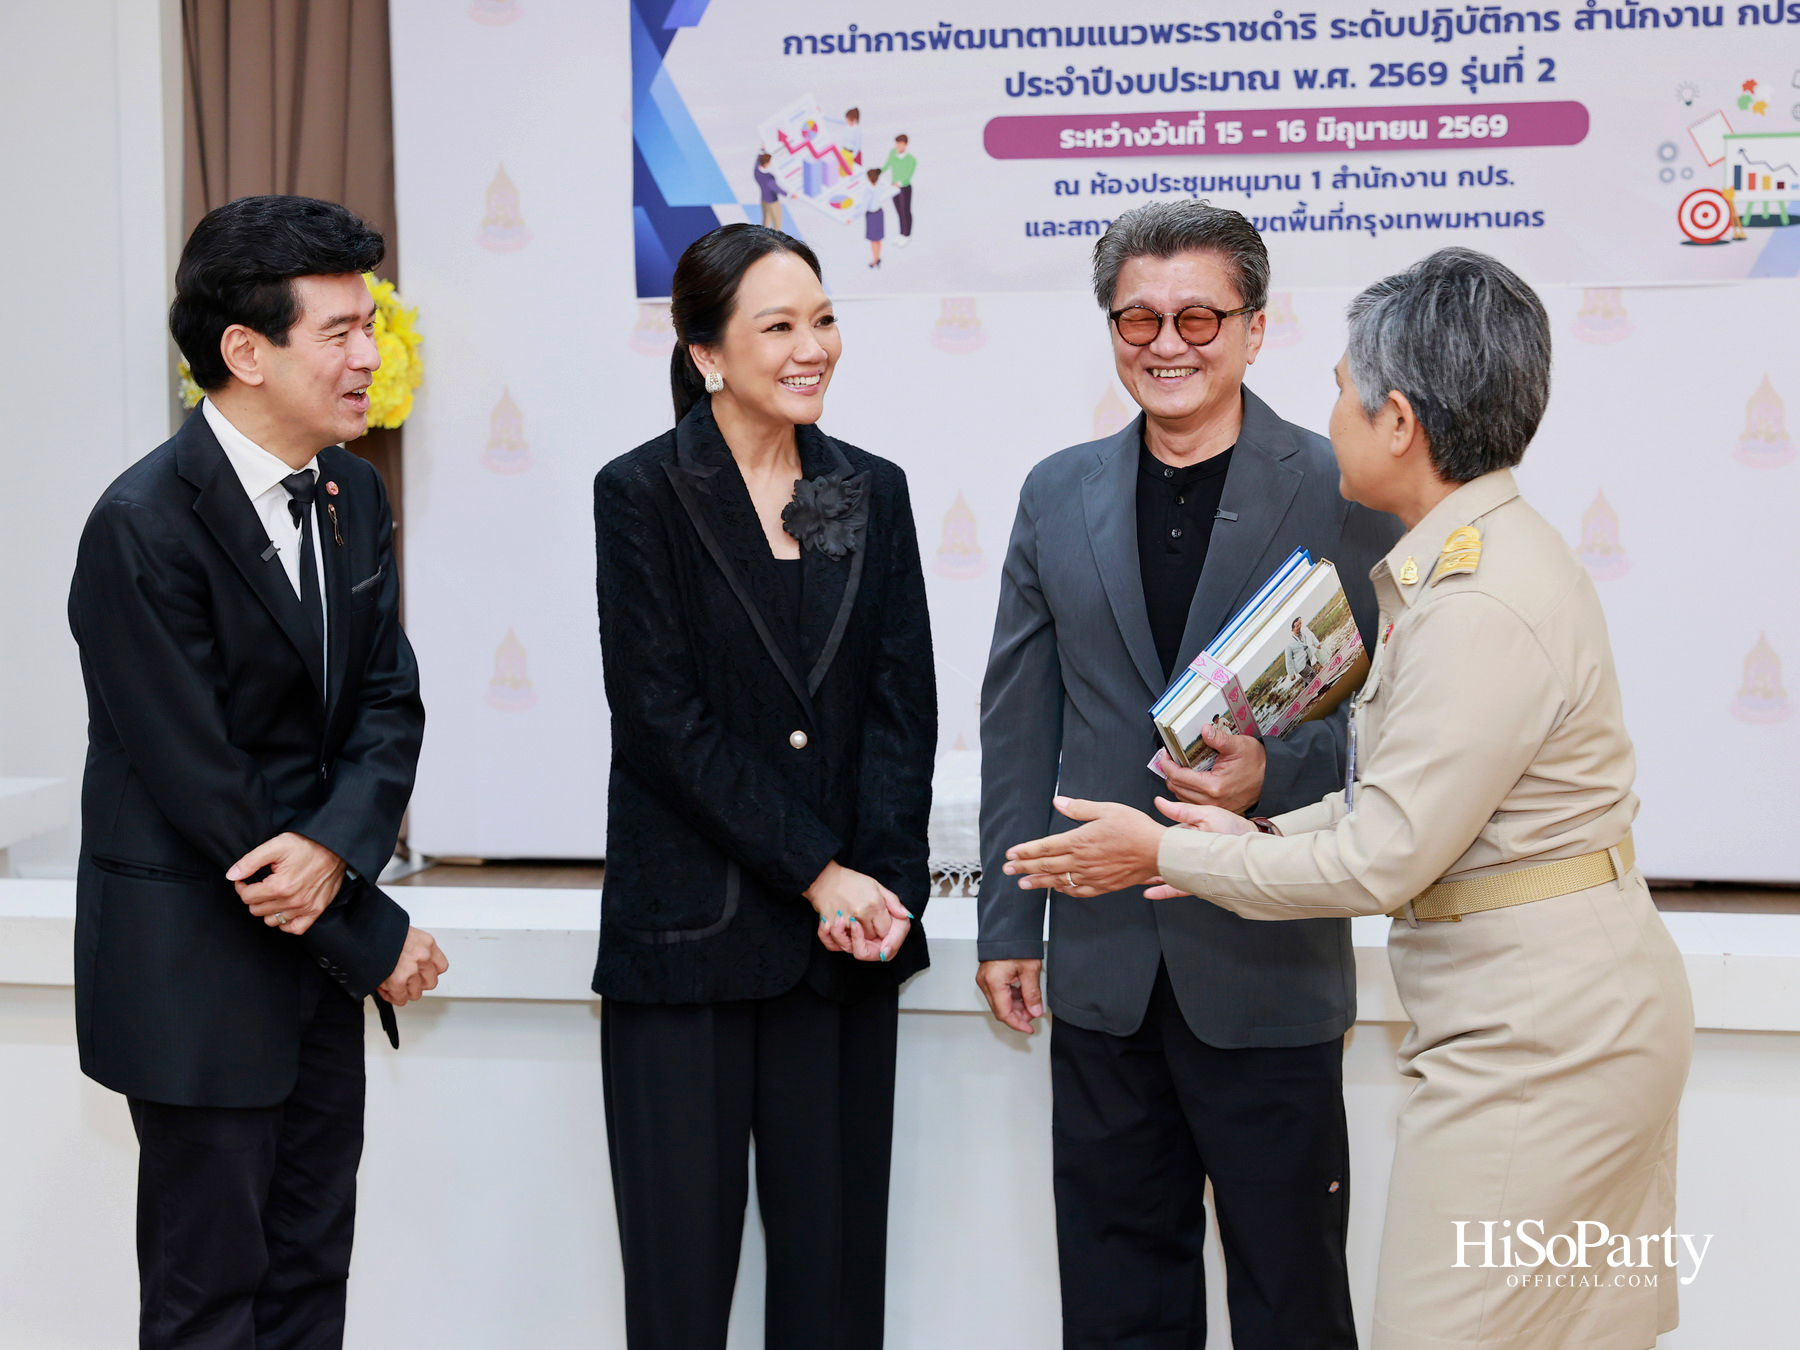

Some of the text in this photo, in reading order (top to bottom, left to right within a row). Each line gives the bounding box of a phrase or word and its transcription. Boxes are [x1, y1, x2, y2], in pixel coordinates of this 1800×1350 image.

[783, 10, 1318, 56] การนำการพัฒนาตามแนวพระราชดำริ
[1330, 5, 1561, 43] ระดับปฏิบัติการ
[1573, 0, 1724, 31] สำนักงาน
[1004, 45, 1556, 97] ประจำปีงบประมาณ พ.ศ. 2569 รุ่นที่ 2
[1058, 111, 1207, 150] ระหว่างวันที่
[1214, 121, 1244, 145] 15
[1276, 119, 1308, 143] 16
[1316, 116, 1429, 149] มิถุนายน
[1437, 114, 1509, 139] 2569
[1055, 164, 1516, 200] ณ ห้องประชุมหนุมาน 1 สำนักงาน กปร.
[1025, 200, 1546, 238] และสถา ขตพื้นที่กรุงเทพมหานคร
